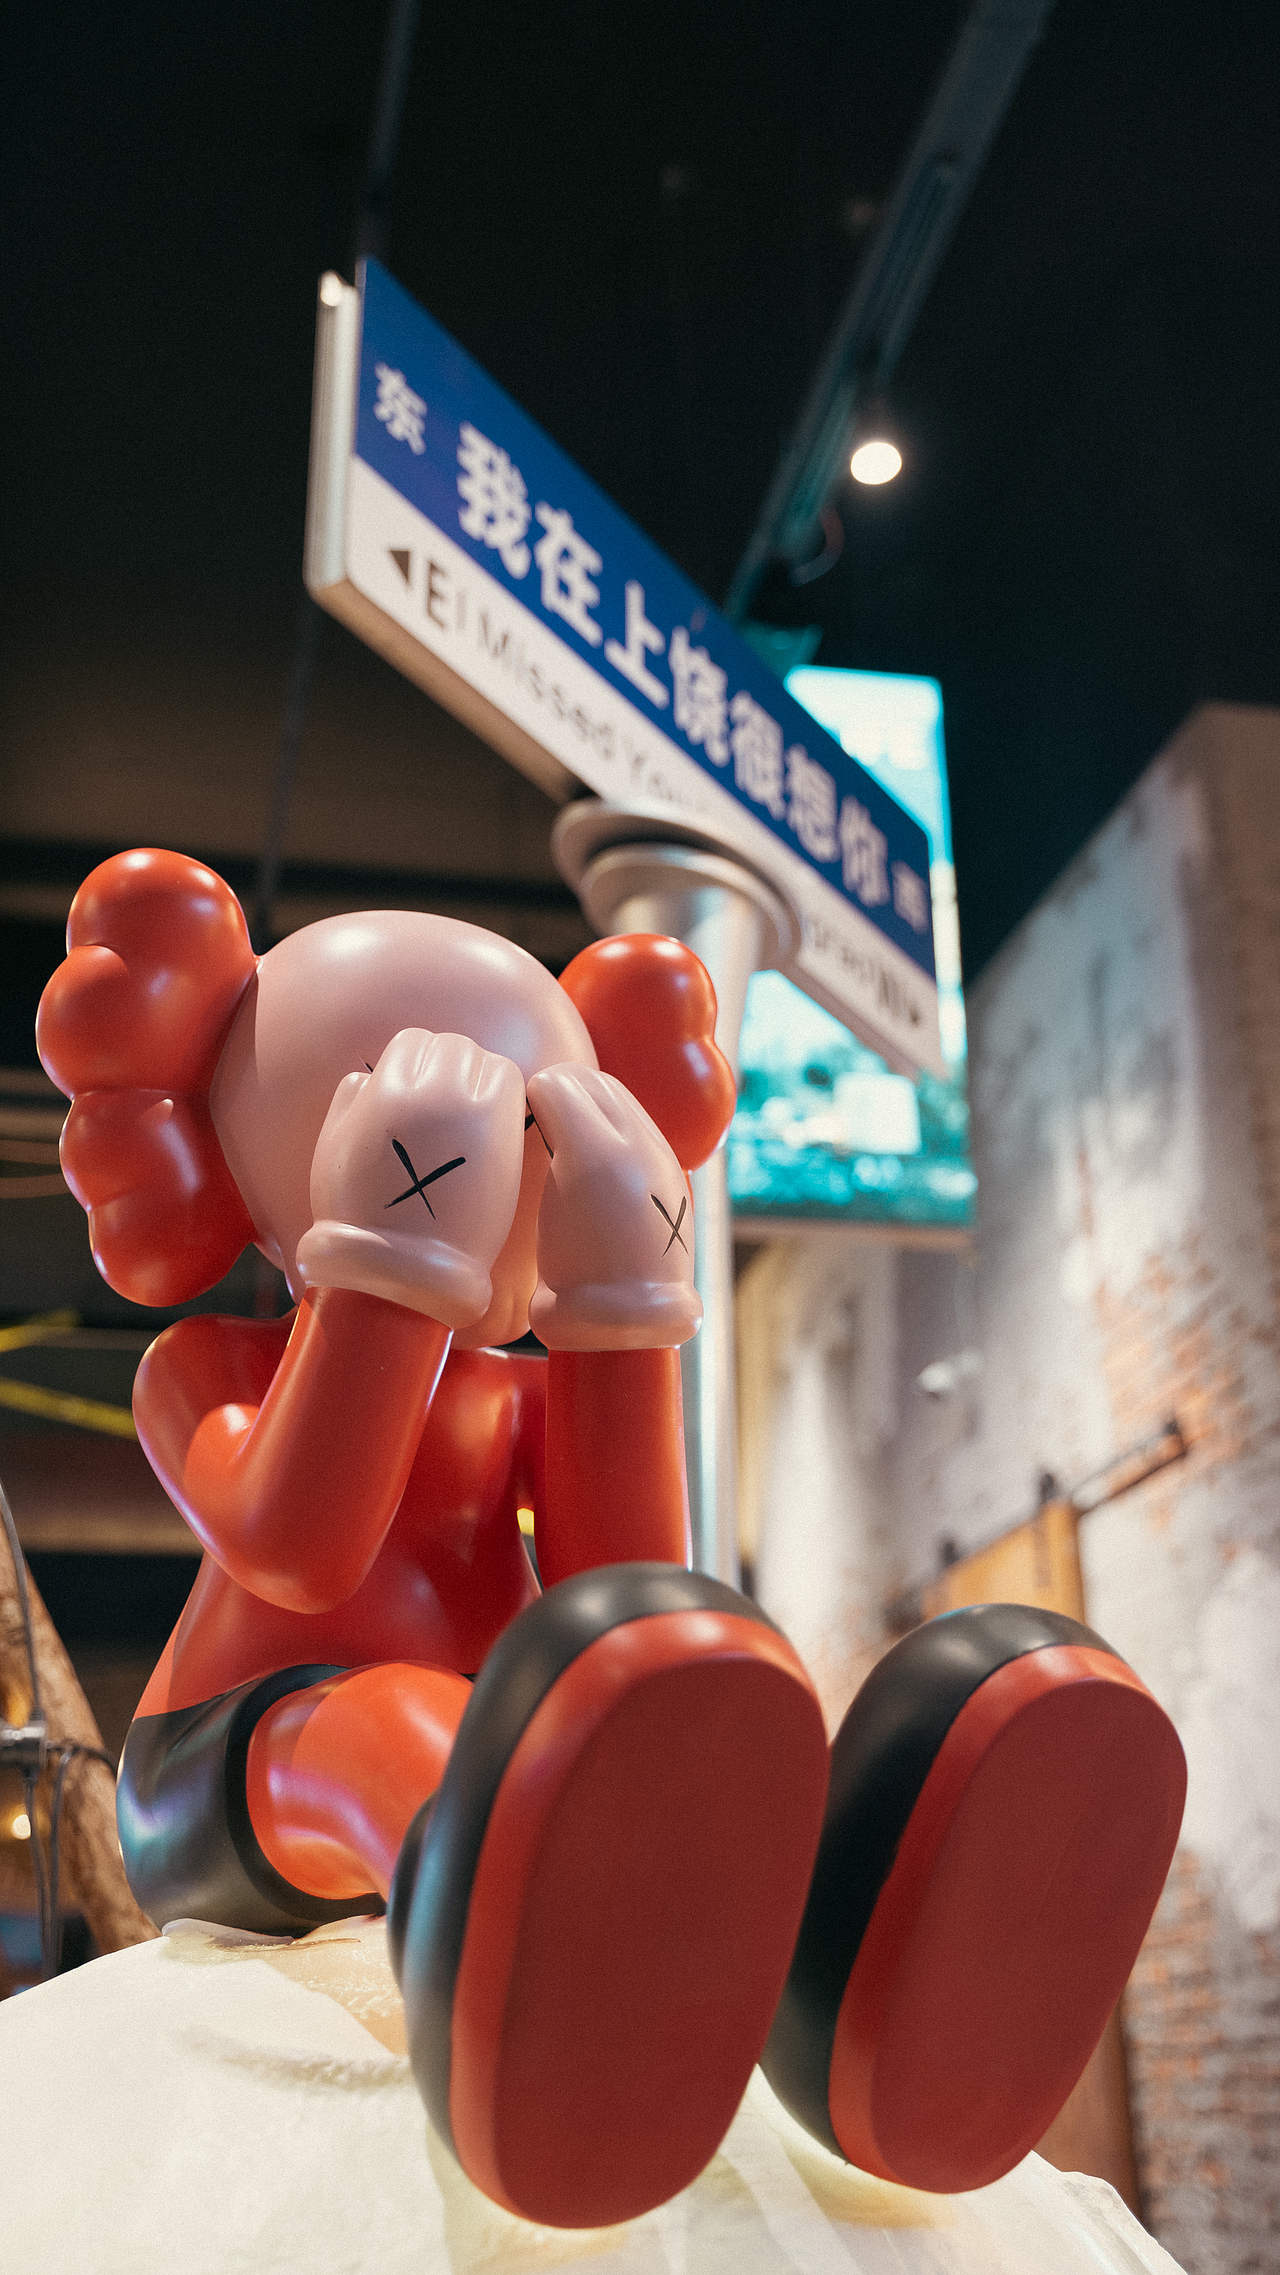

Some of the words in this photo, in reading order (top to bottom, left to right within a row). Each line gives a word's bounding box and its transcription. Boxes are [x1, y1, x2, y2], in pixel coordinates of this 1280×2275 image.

[374, 362, 428, 455] 东
[457, 421, 891, 908] 我在上饶很想你
[426, 560, 447, 631] E
[478, 608, 615, 761] Missed
